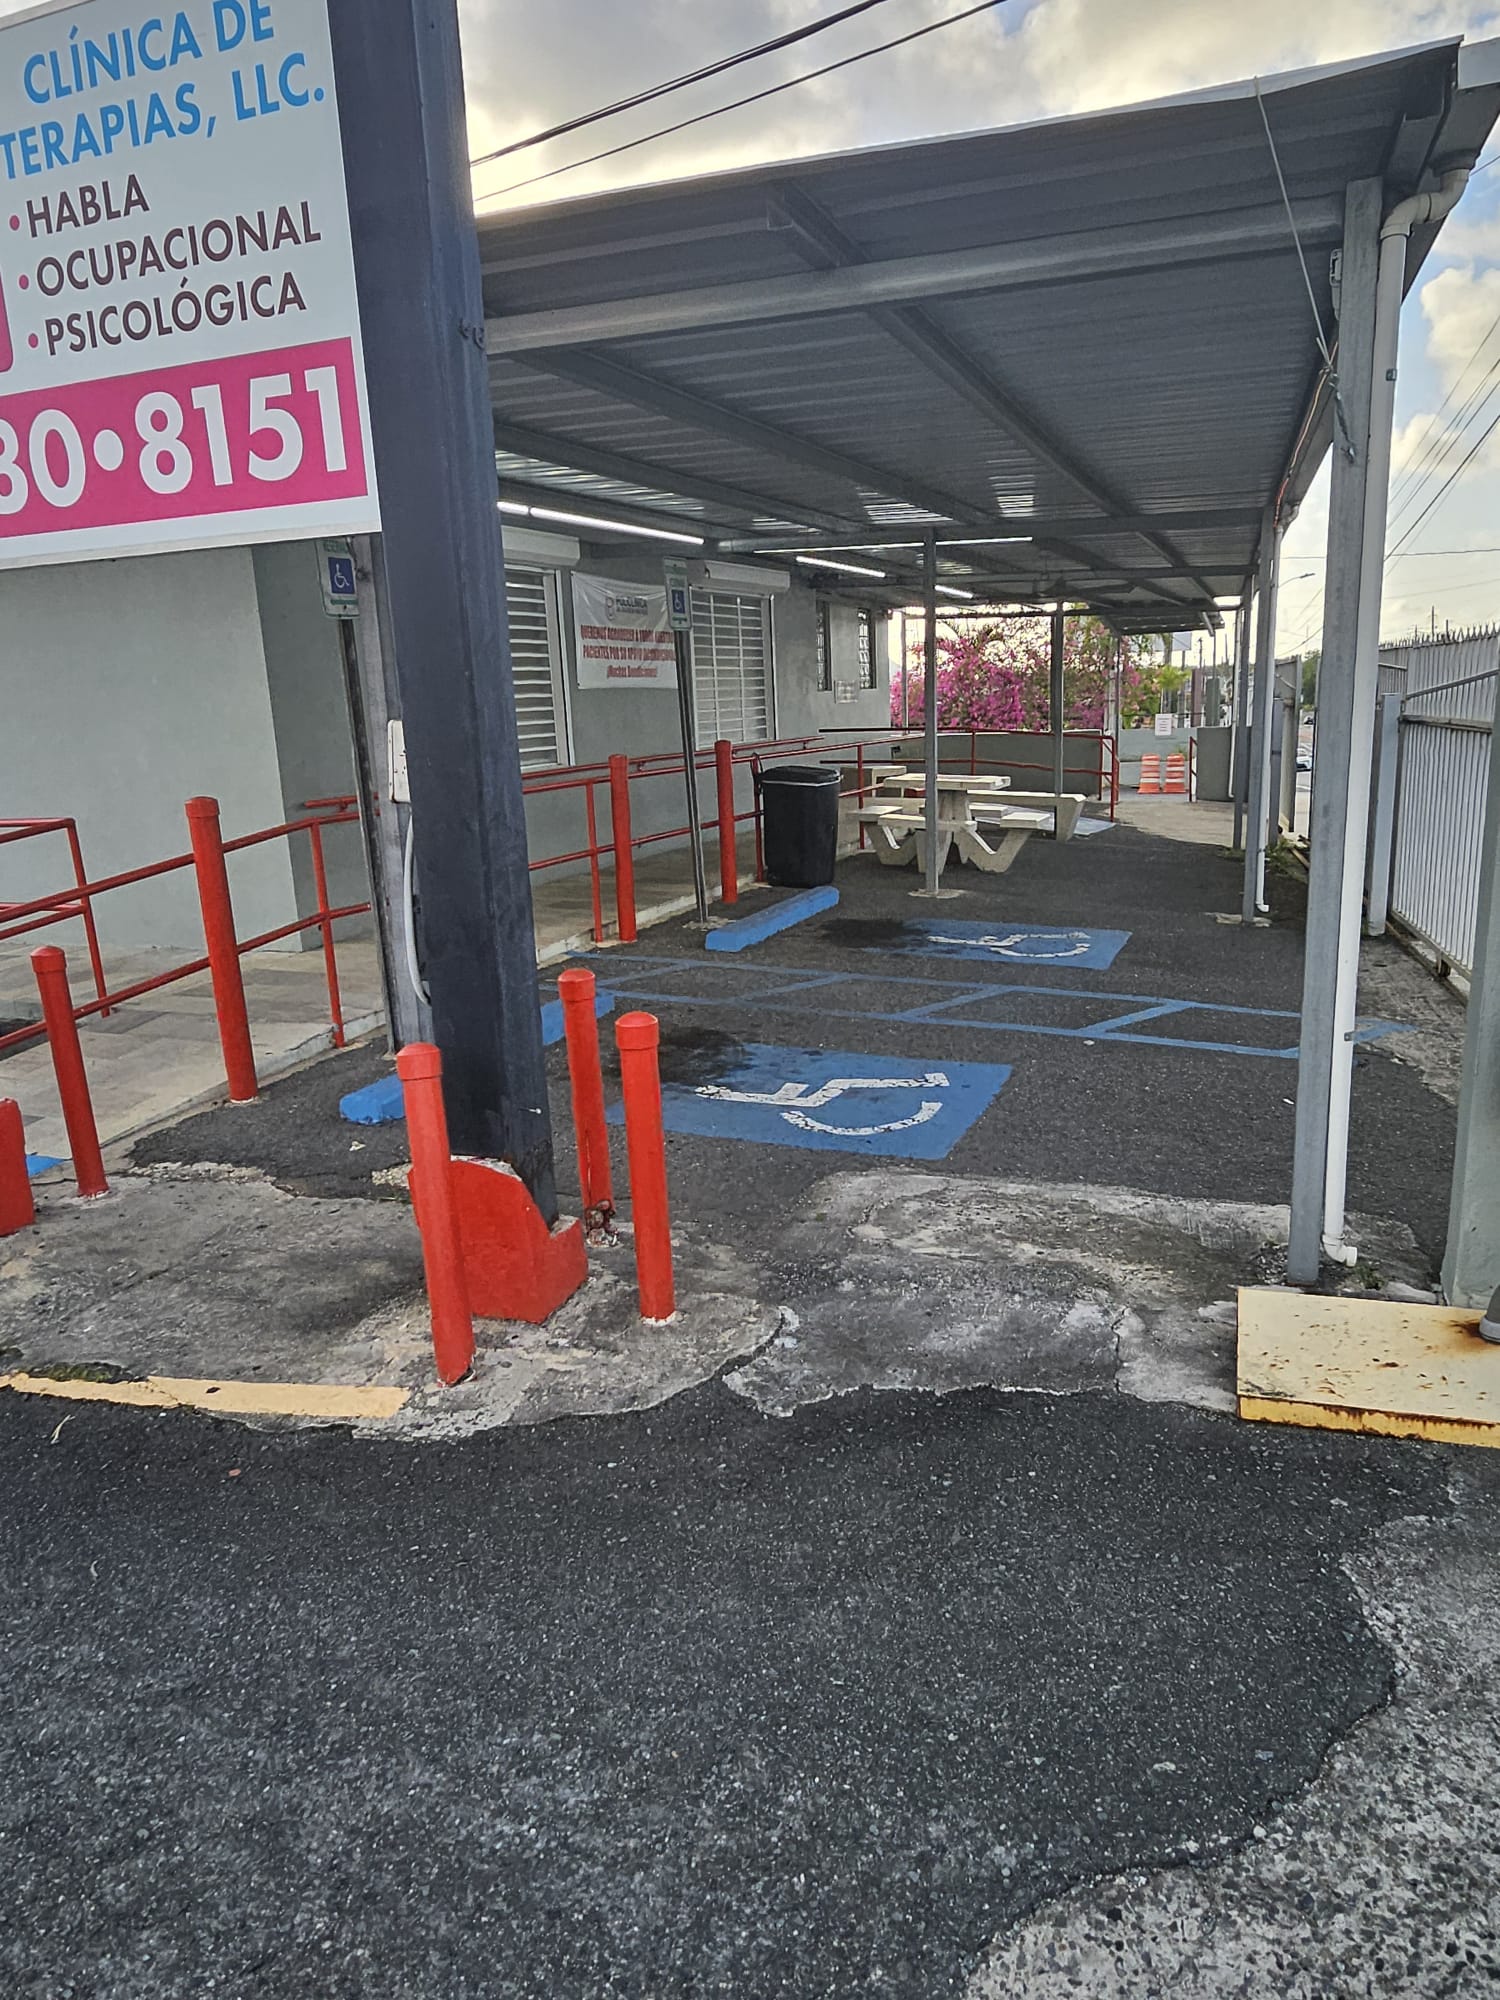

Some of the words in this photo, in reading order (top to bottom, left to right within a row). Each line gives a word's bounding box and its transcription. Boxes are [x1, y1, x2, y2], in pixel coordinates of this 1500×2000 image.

[23, 11, 202, 105] CLÍNICA
[212, 0, 274, 51] DE
[231, 52, 324, 121] LLC.
[26, 174, 150, 238] HABLA
[36, 201, 321, 296] OCUPACIONAL
[45, 271, 307, 356] PSICOLÓGICA
